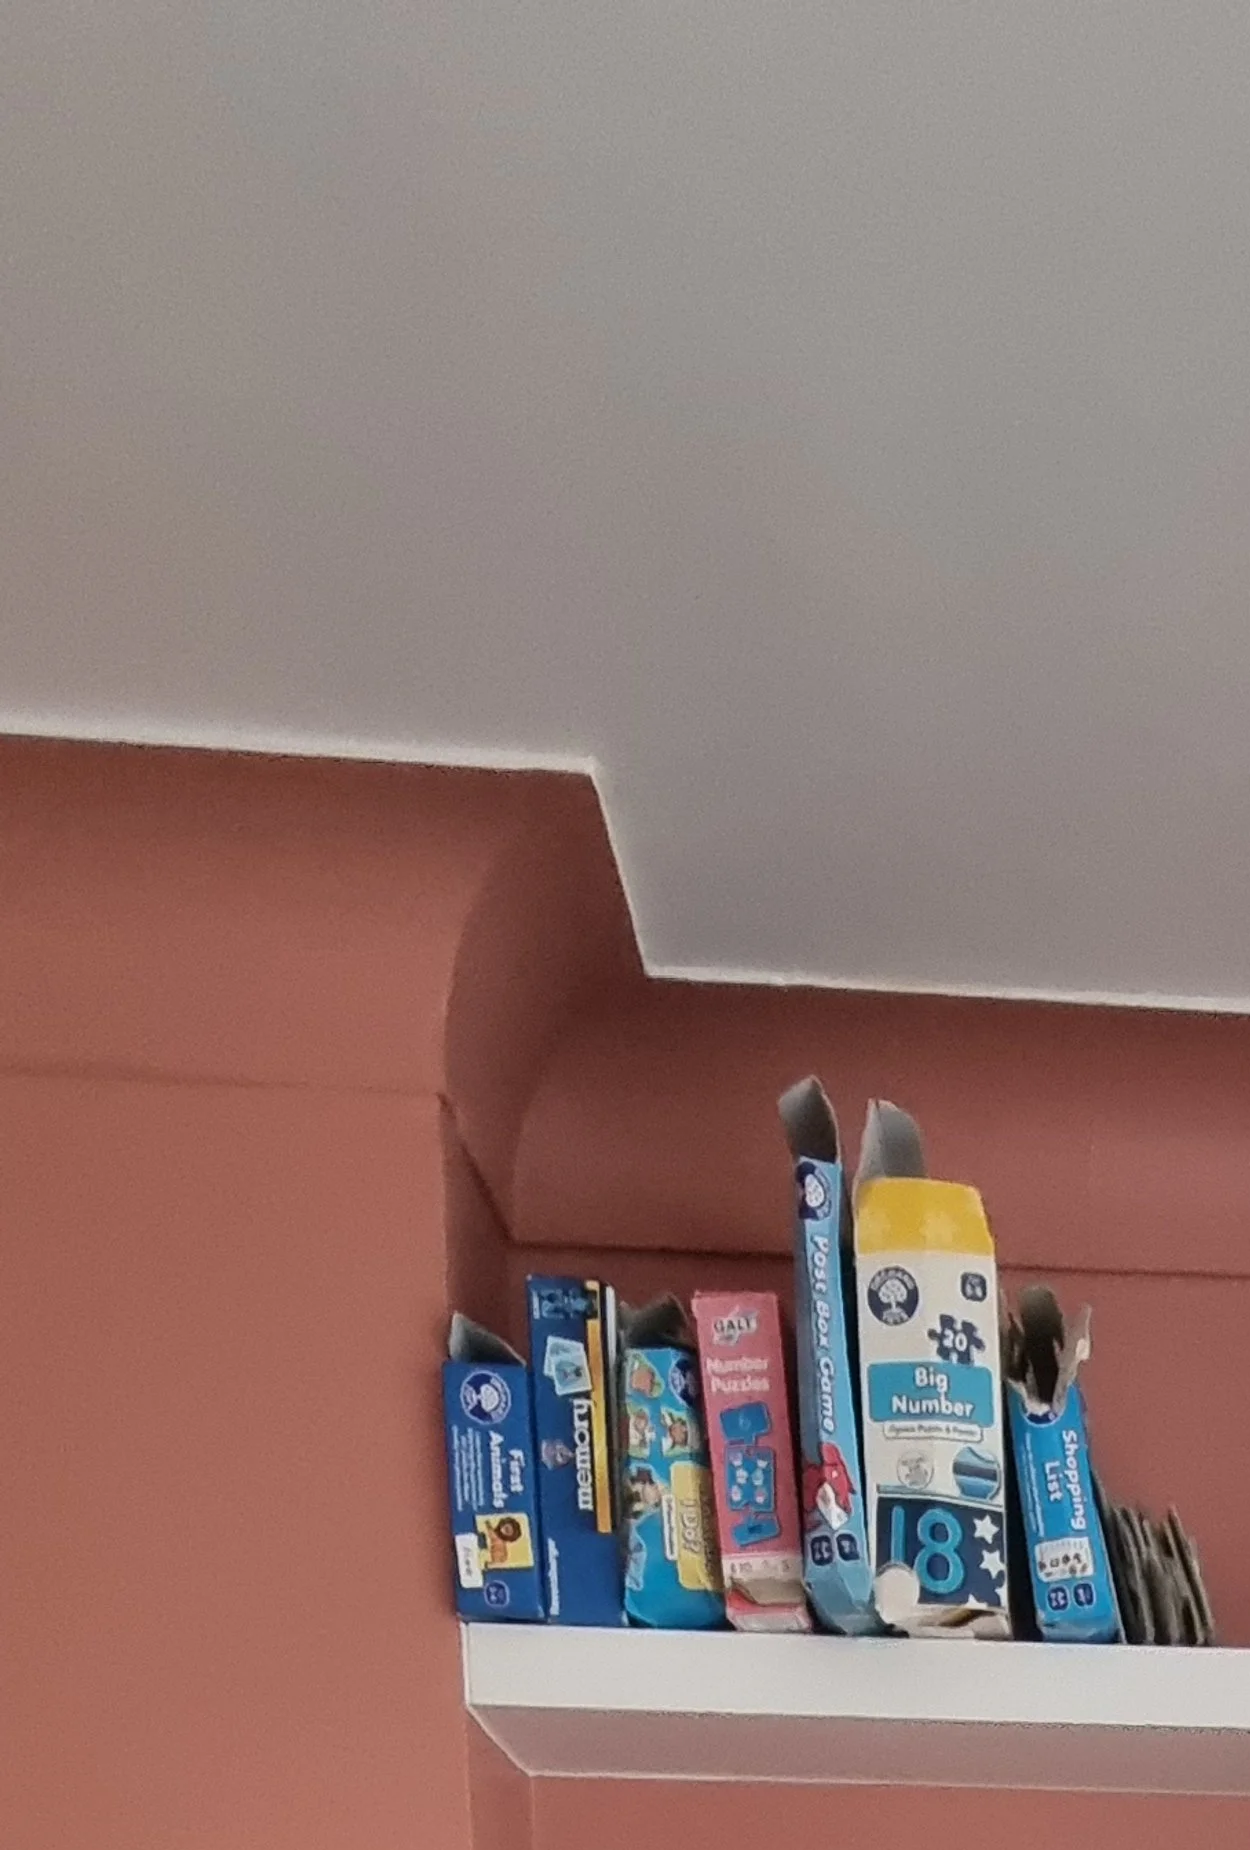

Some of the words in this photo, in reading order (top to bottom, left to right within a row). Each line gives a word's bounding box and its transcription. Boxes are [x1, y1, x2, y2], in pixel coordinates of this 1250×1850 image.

[811, 1235, 829, 1296] Post
[815, 1300, 831, 1349] Box
[942, 1328, 967, 1351] 20
[706, 1357, 768, 1373] Number
[710, 1375, 770, 1393] Puzzles
[915, 1367, 948, 1393] Big
[818, 1357, 835, 1434] Game
[892, 1393, 974, 1417] Number
[489, 1430, 508, 1508] Animals
[509, 1449, 525, 1492] First
[573, 1398, 594, 1510] memory
[1044, 1461, 1064, 1502] List
[1062, 1430, 1087, 1531] Shopping
[891, 1504, 965, 1595] 18
